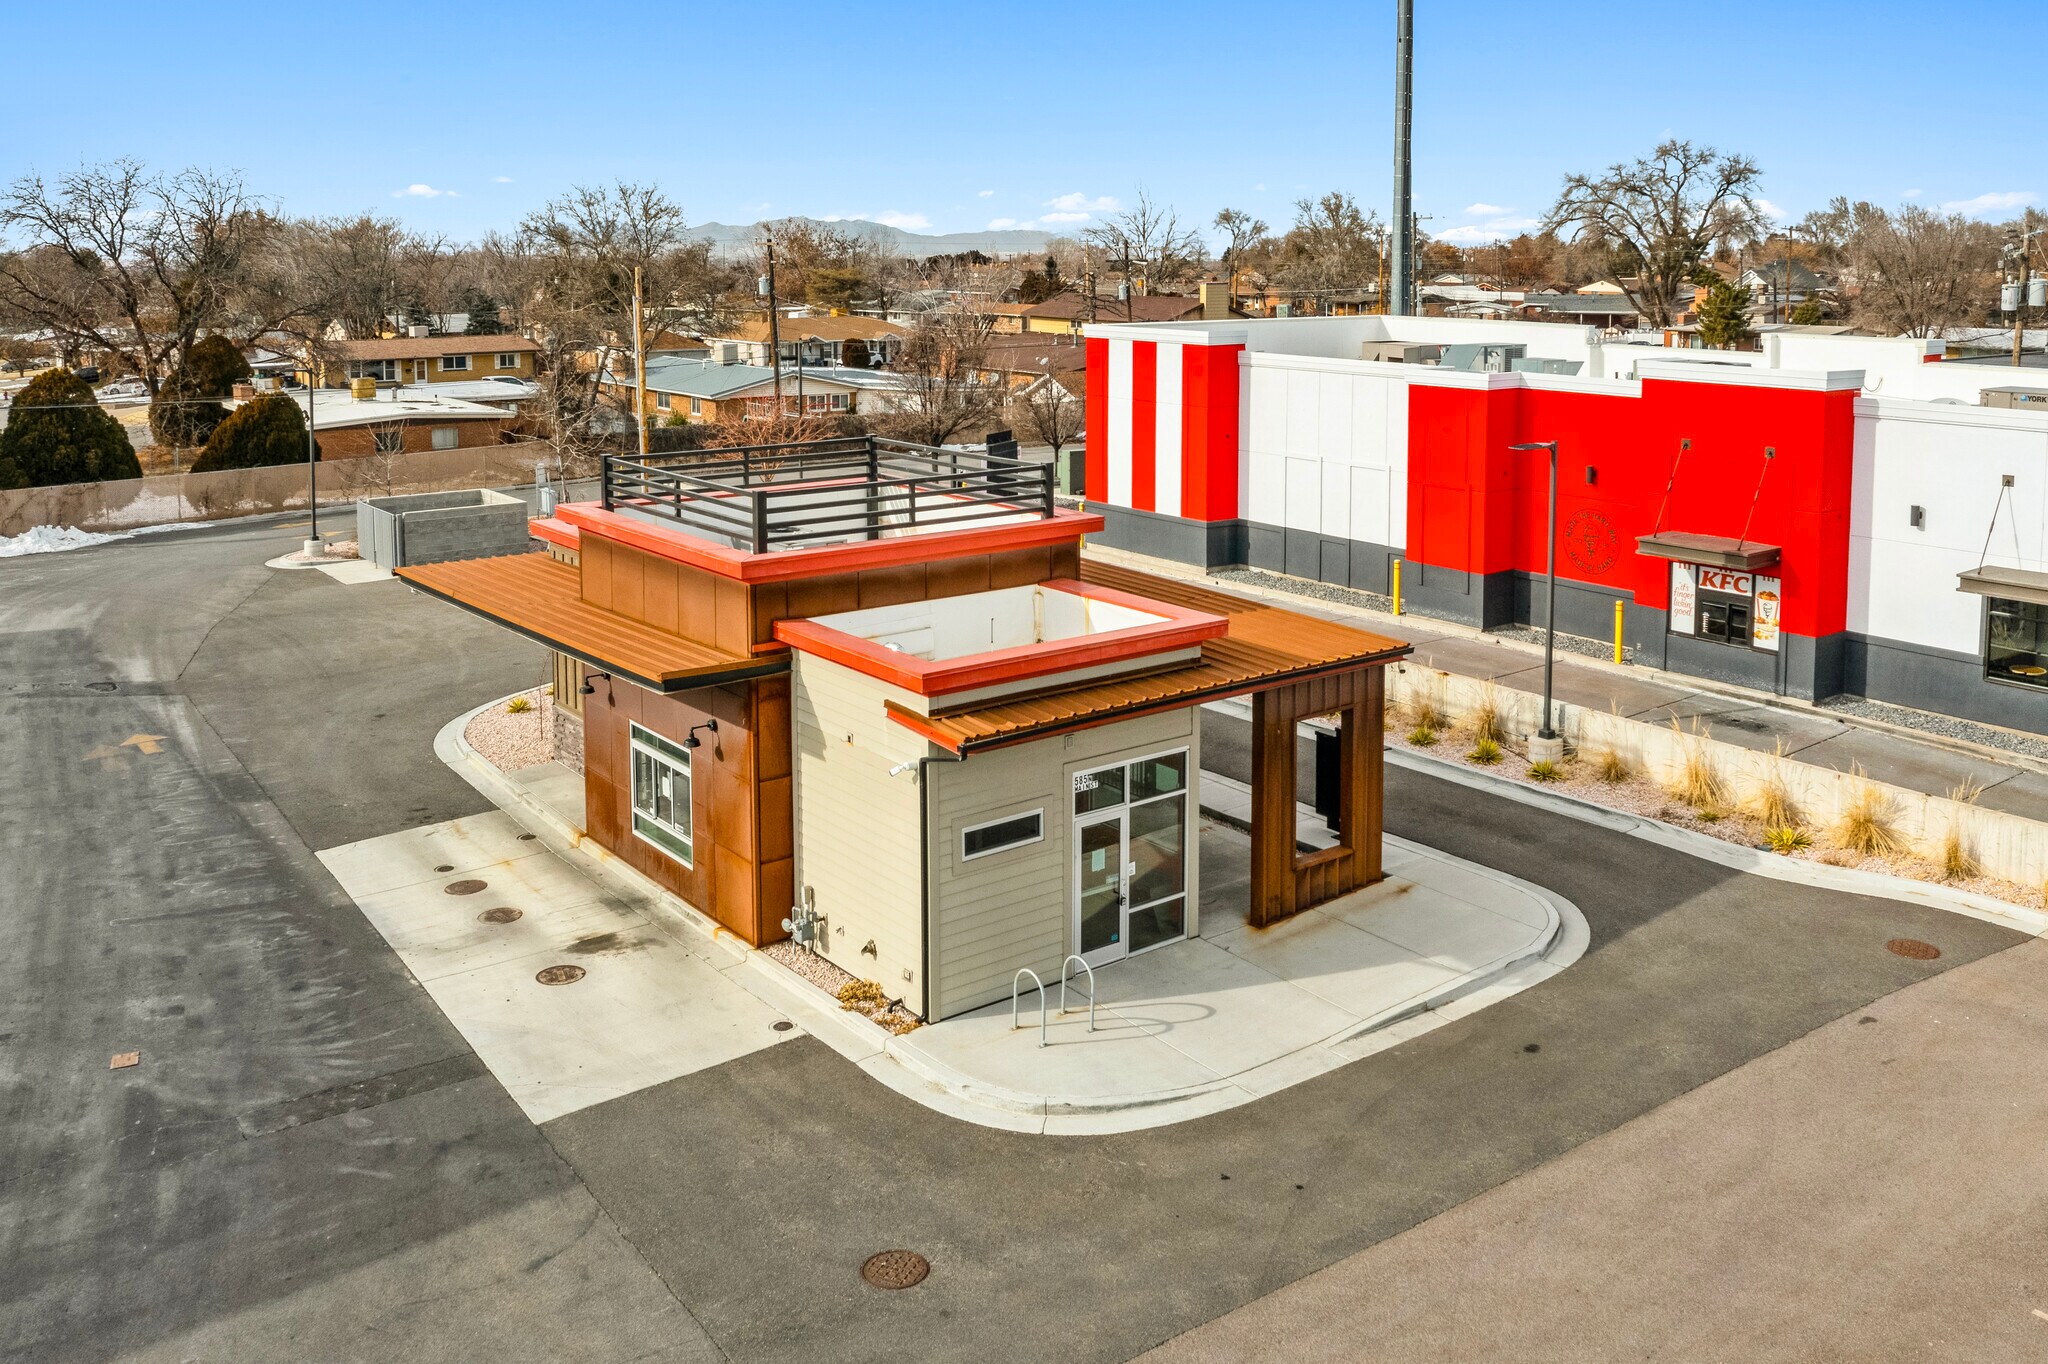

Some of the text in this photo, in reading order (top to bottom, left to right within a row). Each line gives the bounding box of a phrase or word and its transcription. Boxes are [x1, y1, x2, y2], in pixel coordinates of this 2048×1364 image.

[1565, 511, 1618, 544] MADE THE HARD WAY
[1569, 551, 1585, 569] MADE
[1597, 556, 1613, 571] HAND
[1700, 570, 1750, 594] KFC
[1673, 586, 1694, 600] finger
[1075, 774, 1087, 786] 585
[1075, 780, 1098, 791] MAIN ST
